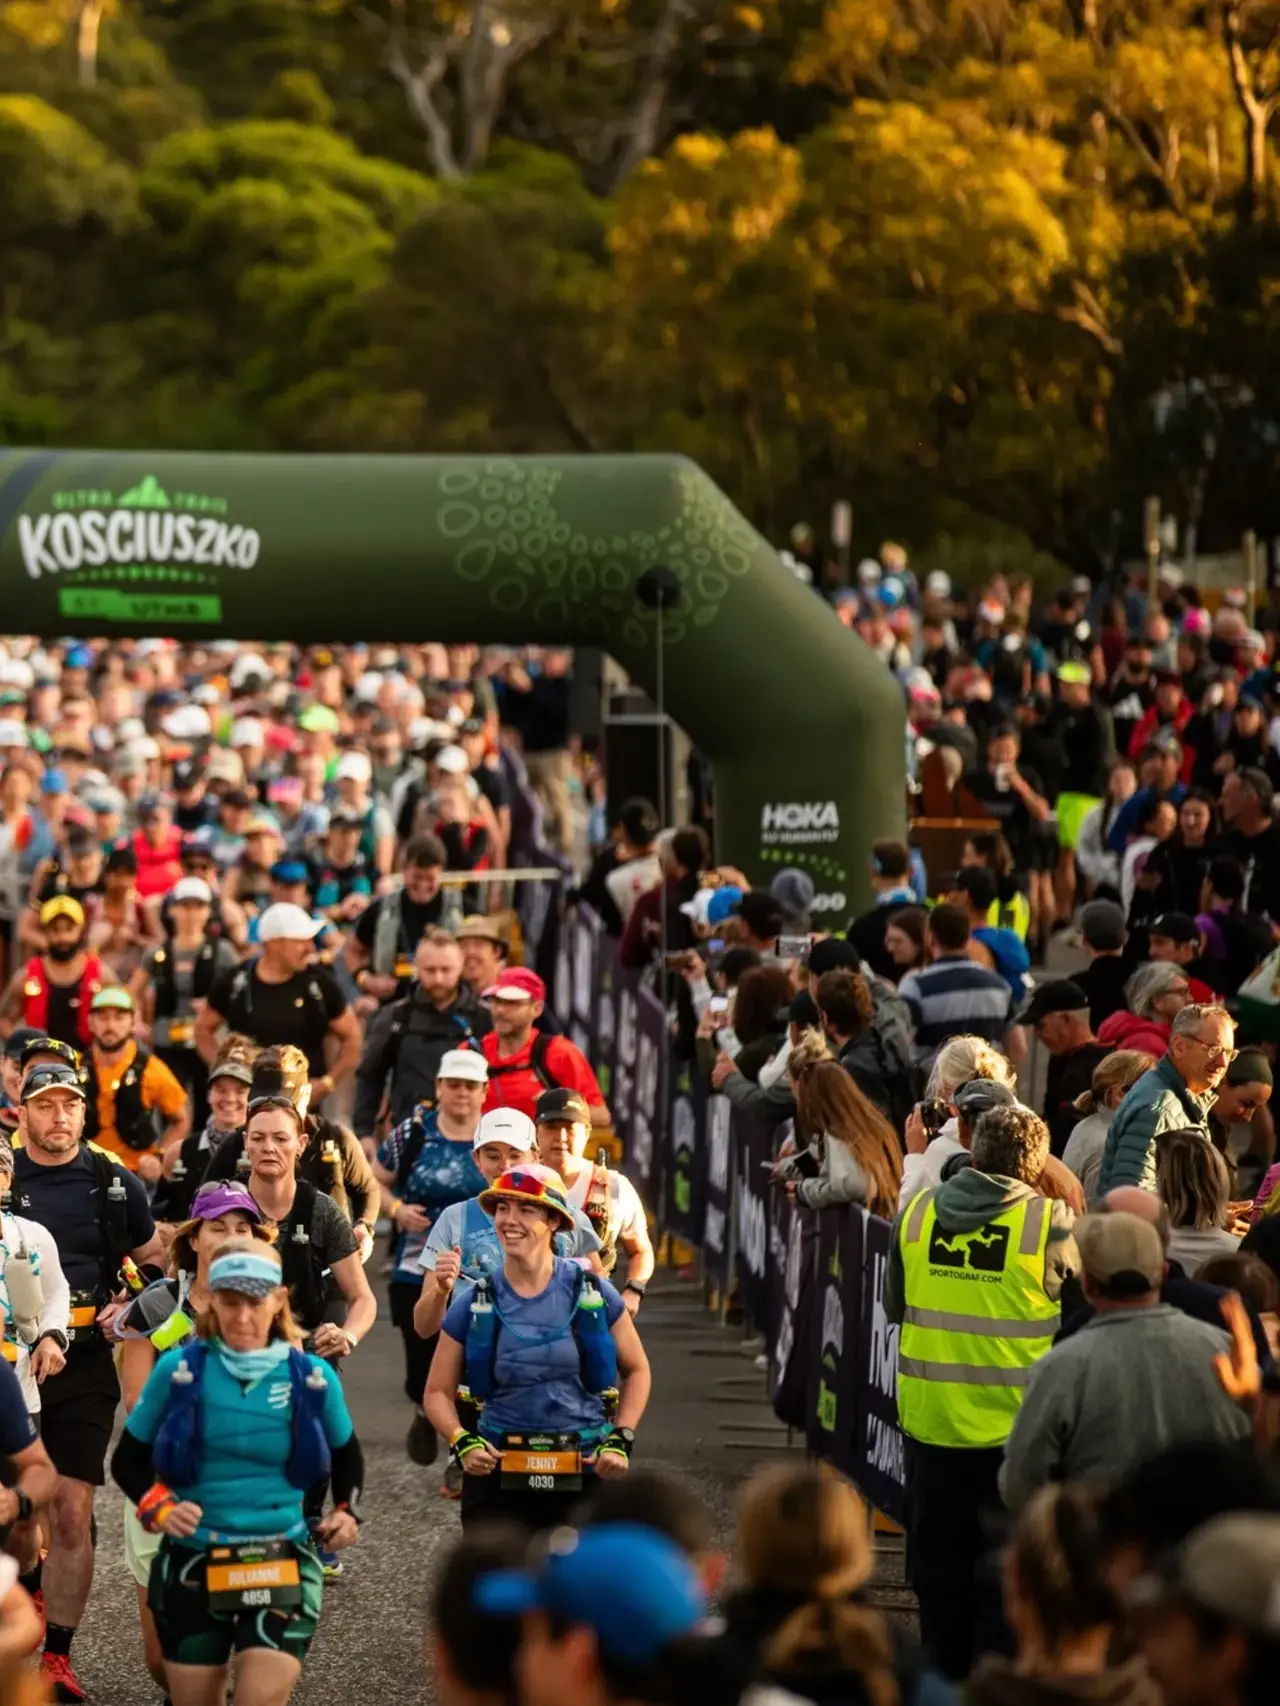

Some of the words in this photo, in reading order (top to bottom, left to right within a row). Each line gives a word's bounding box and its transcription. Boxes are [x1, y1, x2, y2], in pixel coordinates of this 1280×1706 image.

[17, 509, 261, 579] KOSCIUSZKO
[761, 800, 840, 829] HOKA
[928, 1268, 1002, 1284] SPORTOGRAF.COM
[526, 1455, 558, 1470] JENNY
[528, 1475, 555, 1489] 4030
